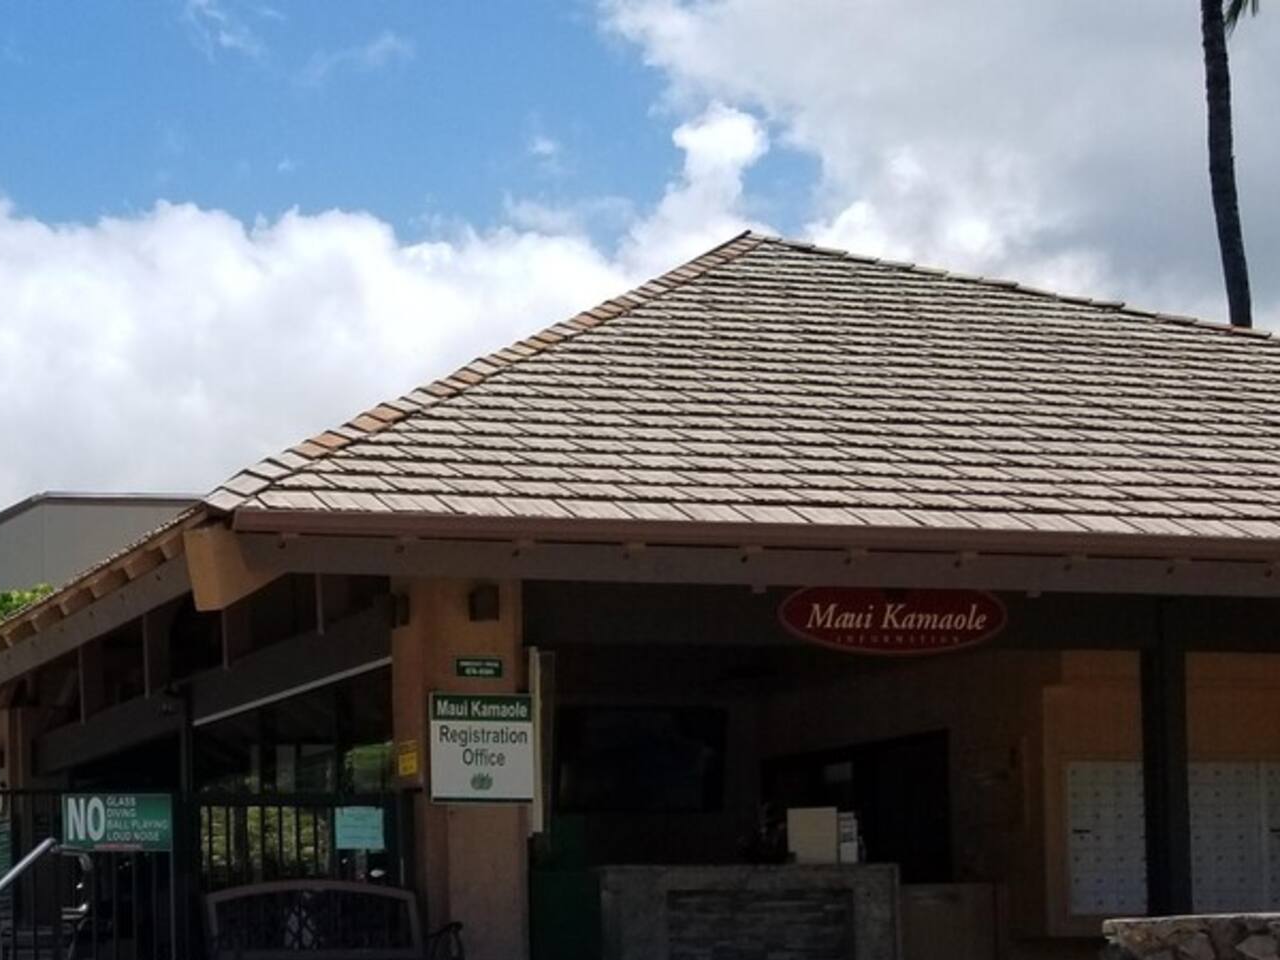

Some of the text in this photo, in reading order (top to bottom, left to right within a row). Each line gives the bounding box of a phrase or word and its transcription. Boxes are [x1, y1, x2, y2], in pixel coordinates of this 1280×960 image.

[806, 602, 988, 631] Maui Kamaole
[436, 700, 528, 717] Maui Kamaole
[438, 724, 528, 747] Registration
[462, 748, 506, 766] Office
[106, 796, 137, 807] GLASS
[67, 796, 106, 841] NO
[106, 808, 137, 818] DIVING
[106, 819, 169, 830] BALL PLAYING
[107, 831, 161, 841] LOUD NOISE
